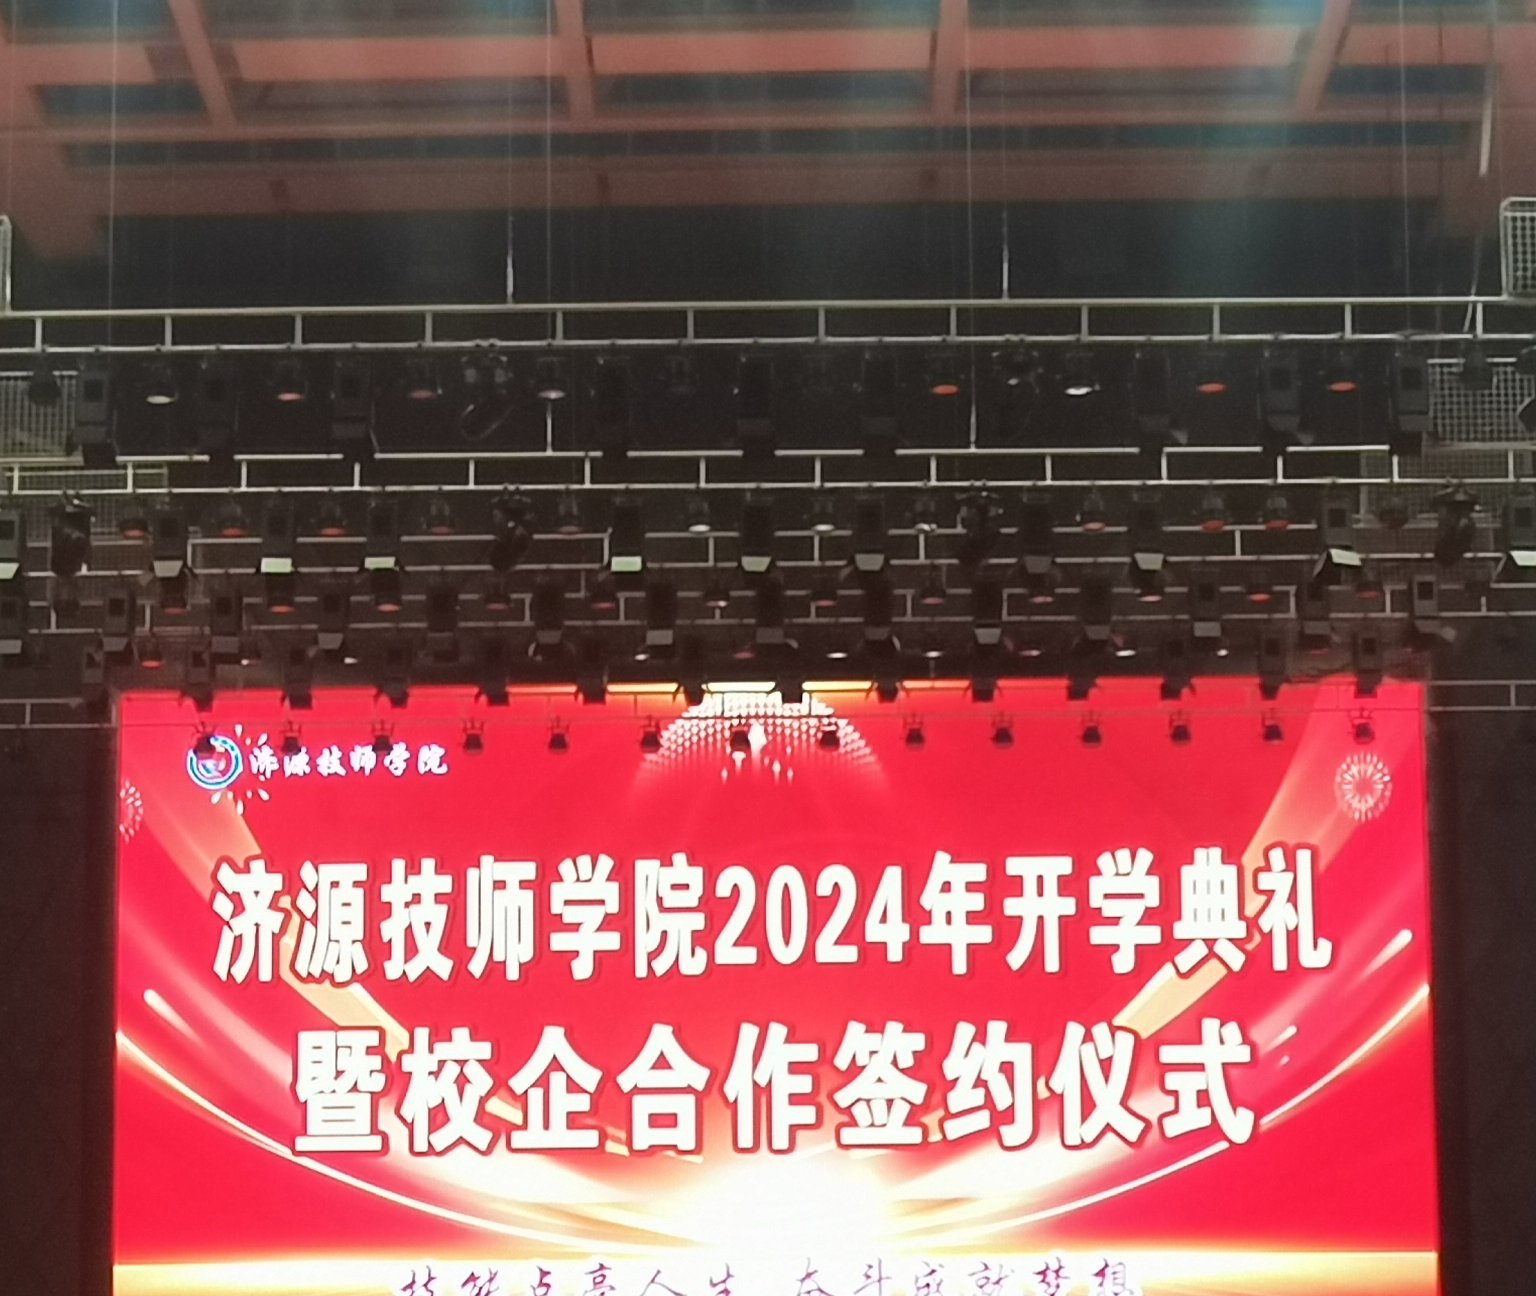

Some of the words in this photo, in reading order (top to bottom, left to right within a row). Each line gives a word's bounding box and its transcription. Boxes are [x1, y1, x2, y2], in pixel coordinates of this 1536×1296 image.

[248, 741, 449, 778] 济源技师学院
[210, 844, 1334, 986] 济源技师学院2024年开学典礼
[293, 1015, 1257, 1154] 暨校企合作签约仪式
